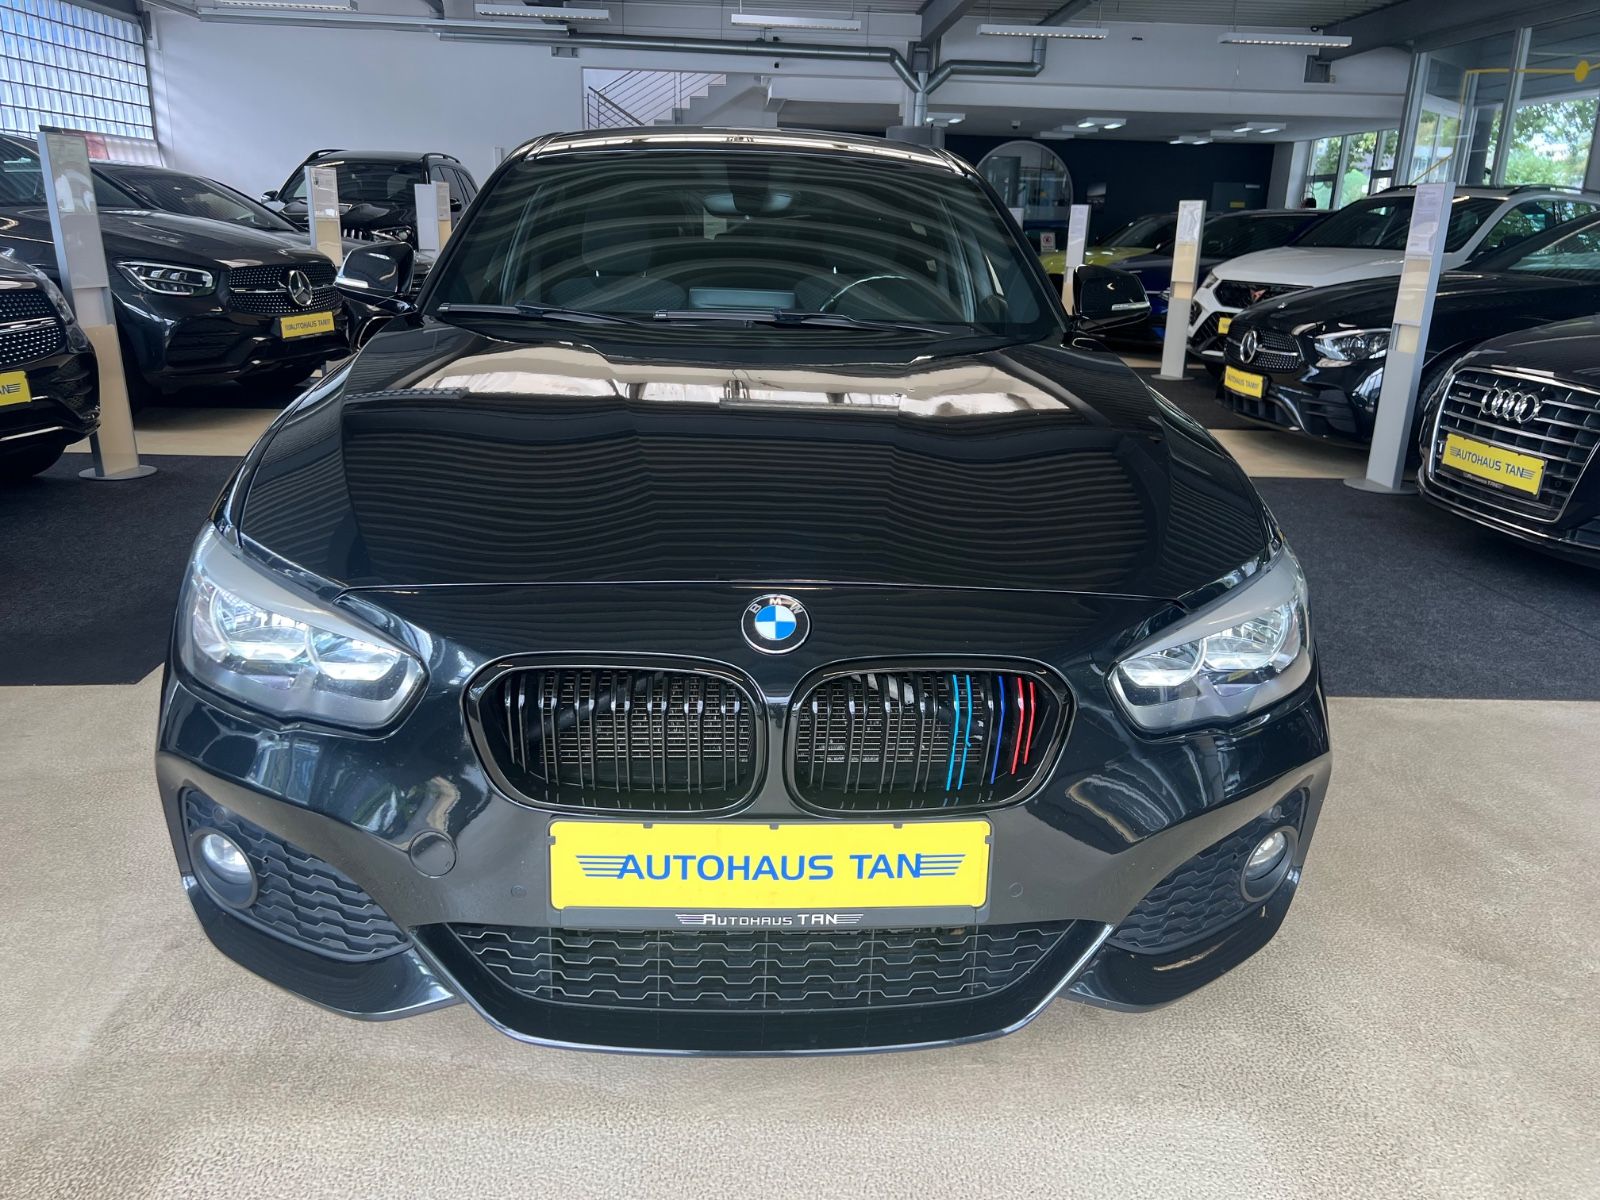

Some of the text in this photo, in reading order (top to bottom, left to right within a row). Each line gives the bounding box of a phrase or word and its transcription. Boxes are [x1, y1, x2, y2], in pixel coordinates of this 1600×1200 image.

[1456, 448, 1524, 478] AUTOHAUS TAN
[749, 597, 804, 614] BMW
[617, 853, 921, 880] AUTOHAUS TAN
[702, 914, 837, 926] AUTOHAUS TAN
